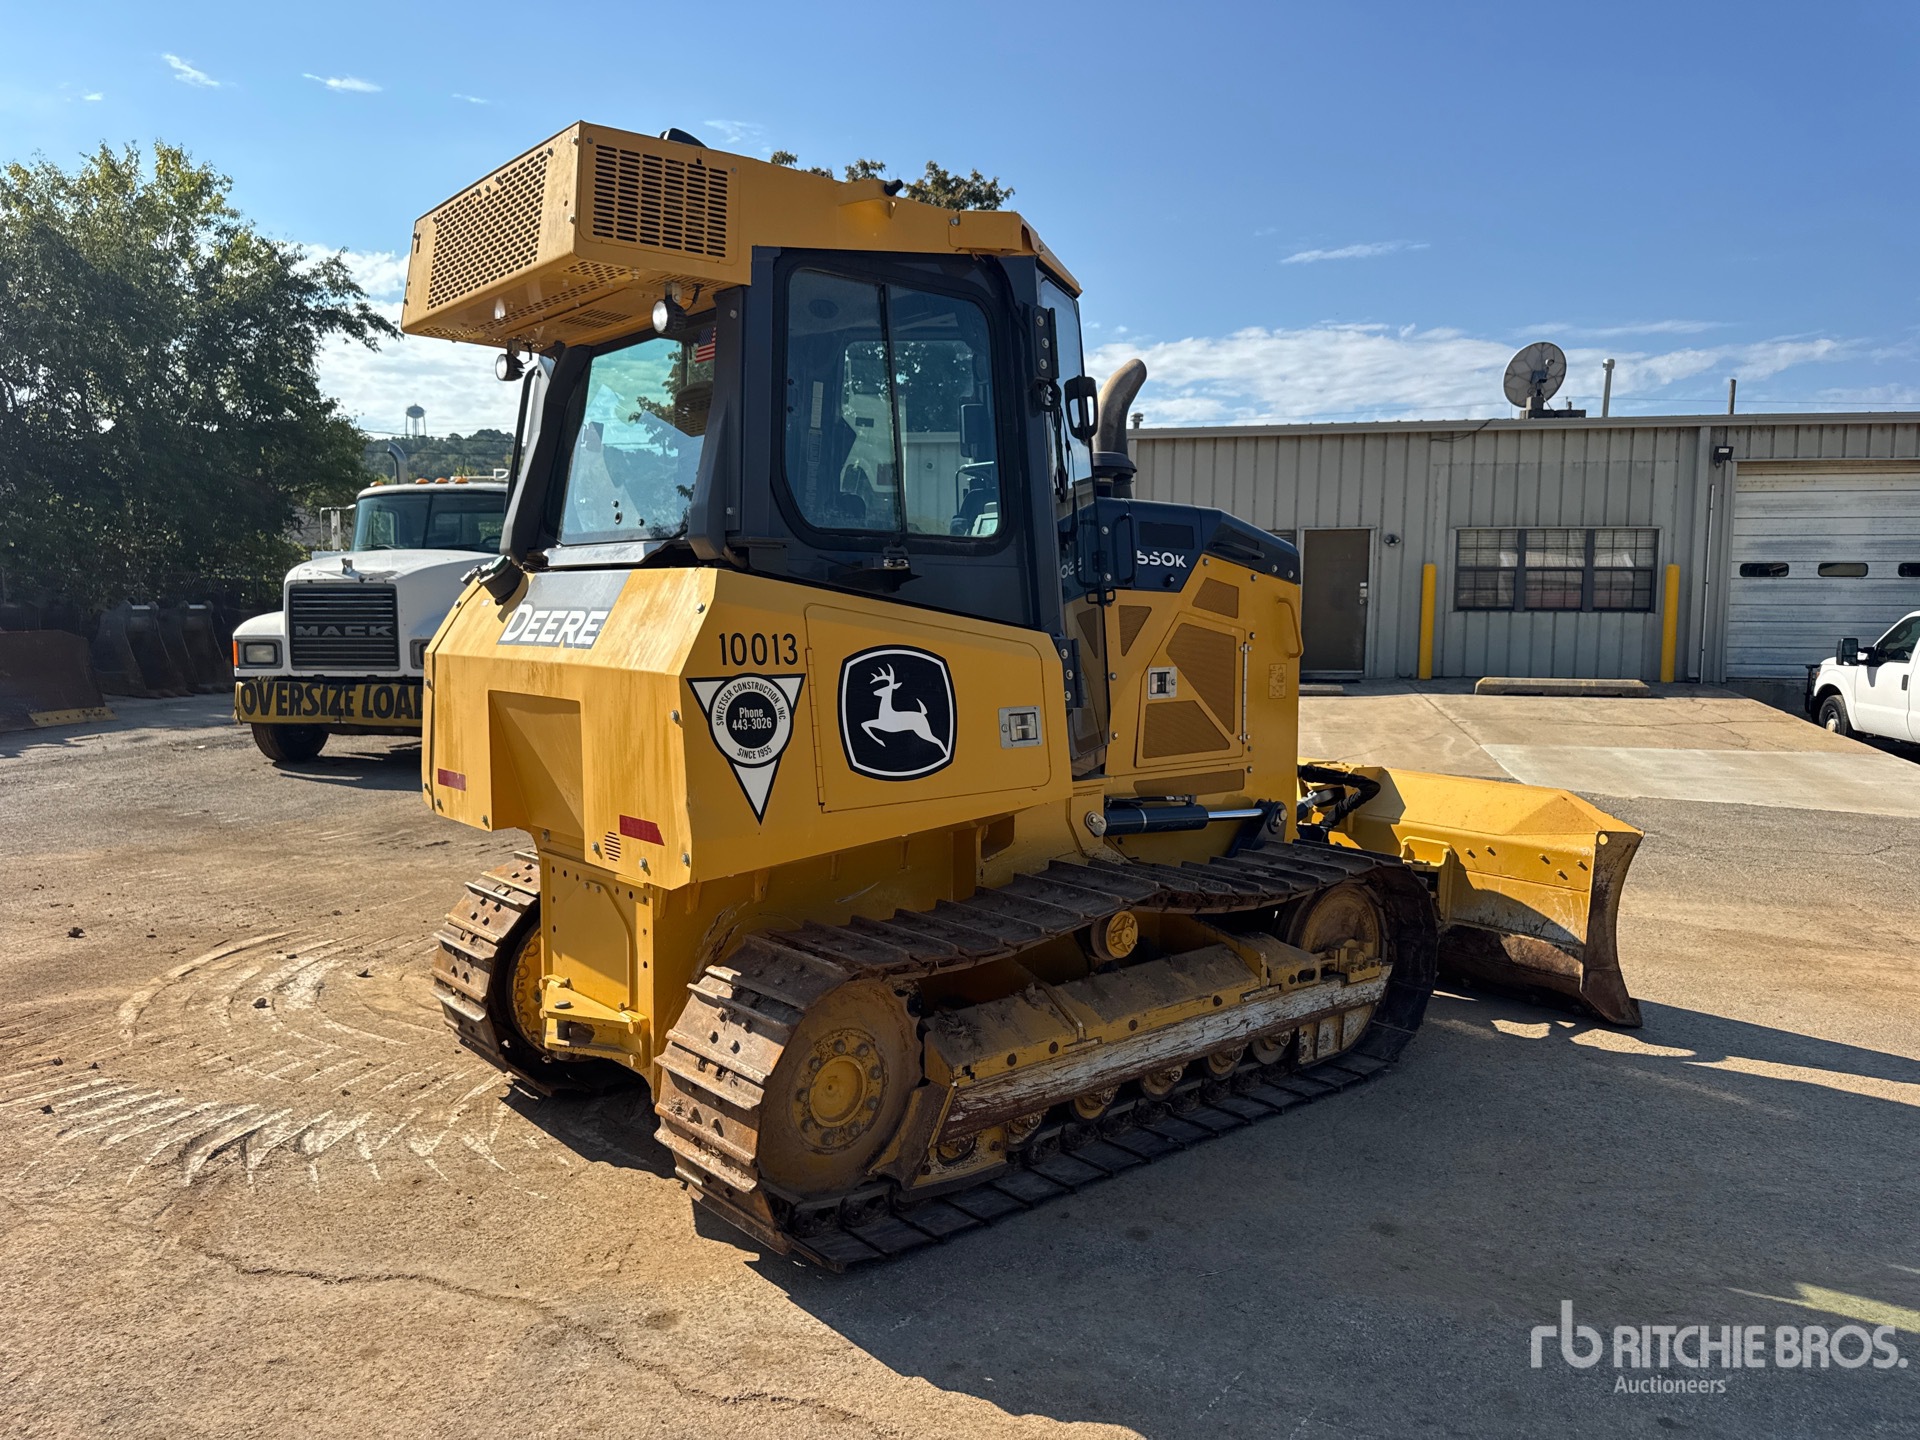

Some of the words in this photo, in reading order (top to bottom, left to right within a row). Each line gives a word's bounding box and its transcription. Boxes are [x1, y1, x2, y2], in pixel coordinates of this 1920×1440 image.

[295, 625, 393, 637] MACK
[500, 604, 608, 645] DEERE
[719, 633, 799, 666] 10013
[241, 682, 356, 717] OVERSIZE
[716, 689, 734, 726] SWEETSER
[733, 681, 781, 707] CONSTRUCTION,
[777, 706, 786, 722] INC.
[732, 717, 772, 731] 443-3026
[739, 707, 764, 718] Phone
[737, 747, 757, 759] SINCE
[757, 745, 772, 758] 1955
